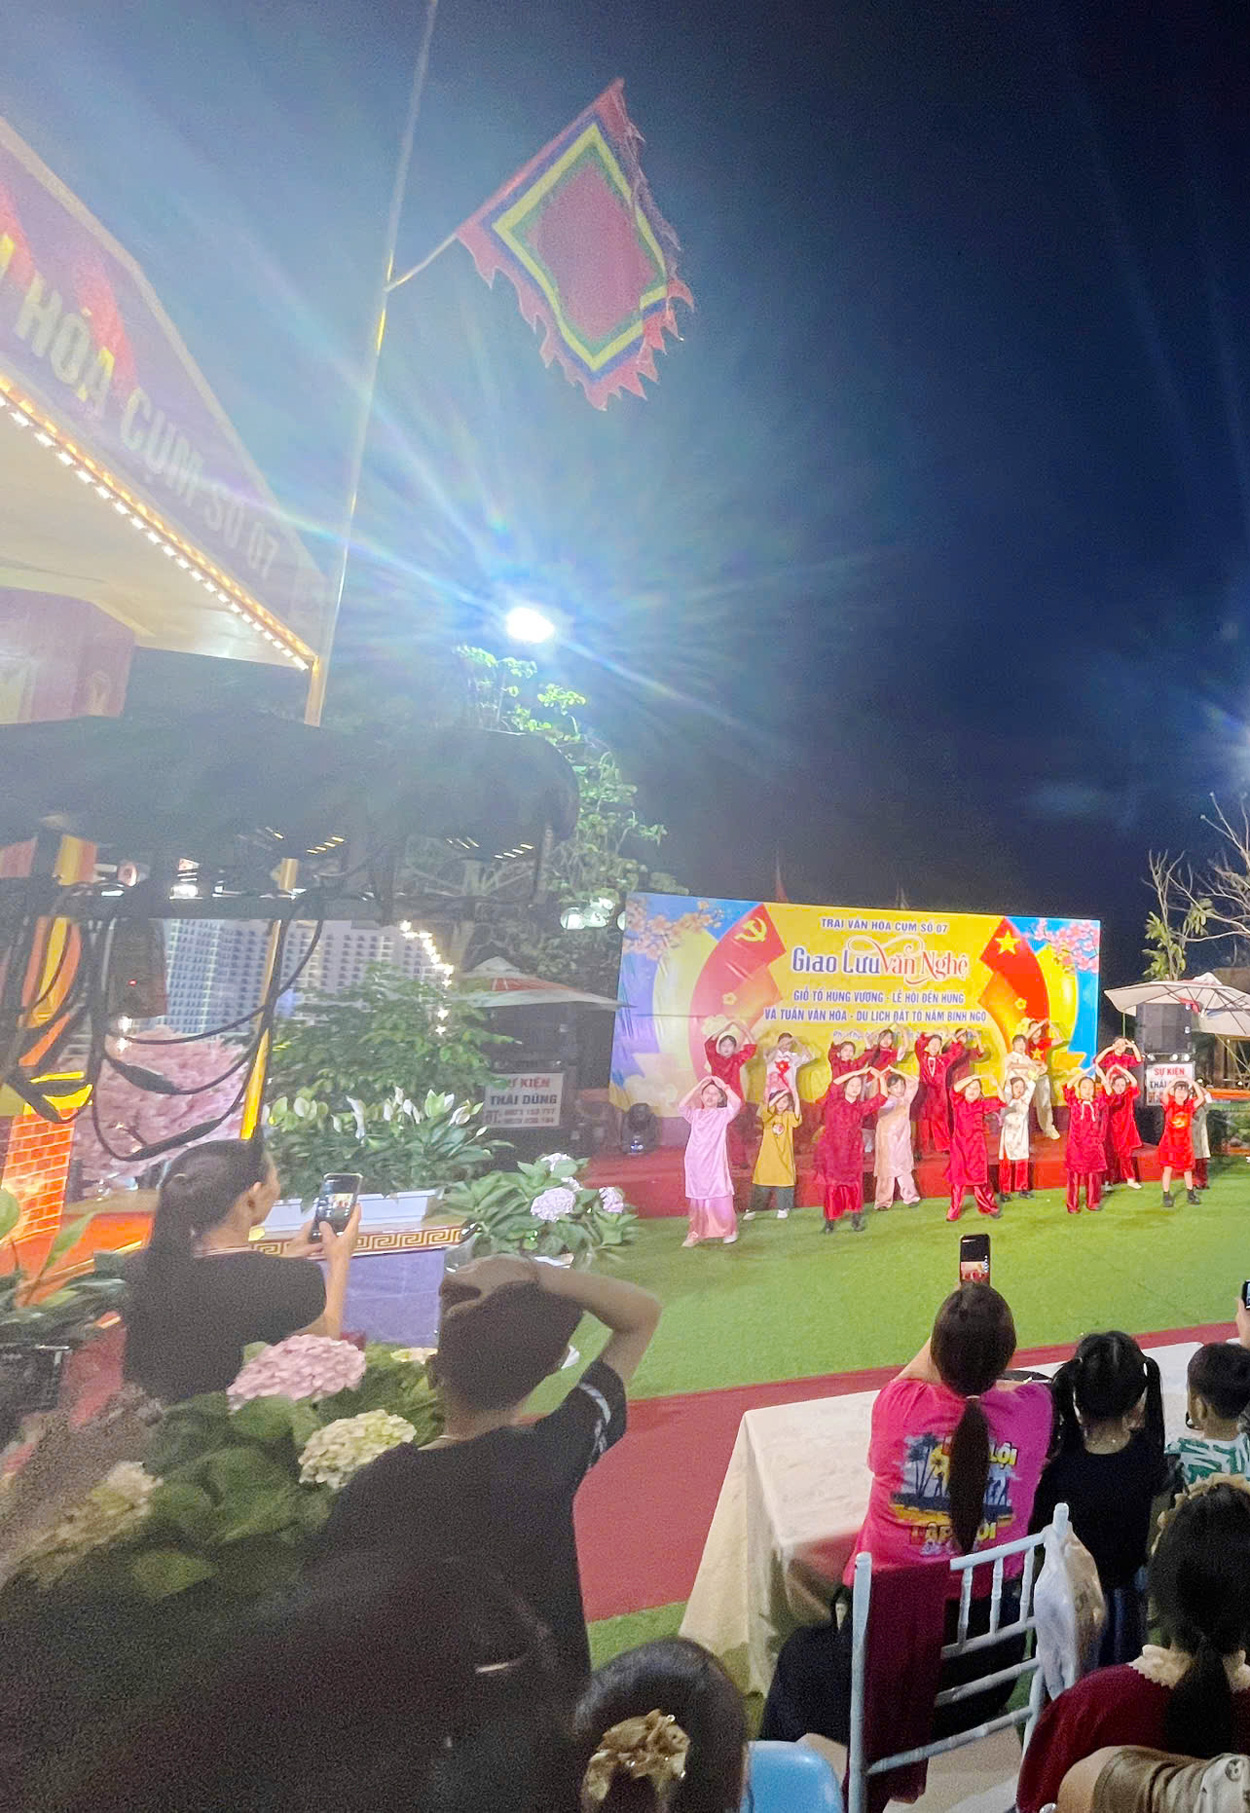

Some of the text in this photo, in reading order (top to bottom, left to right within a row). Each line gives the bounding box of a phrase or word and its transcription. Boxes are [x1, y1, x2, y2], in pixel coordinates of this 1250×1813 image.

[793, 947, 838, 973] Giao
[843, 950, 880, 974] Lưu
[917, 951, 968, 982] Nghệ
